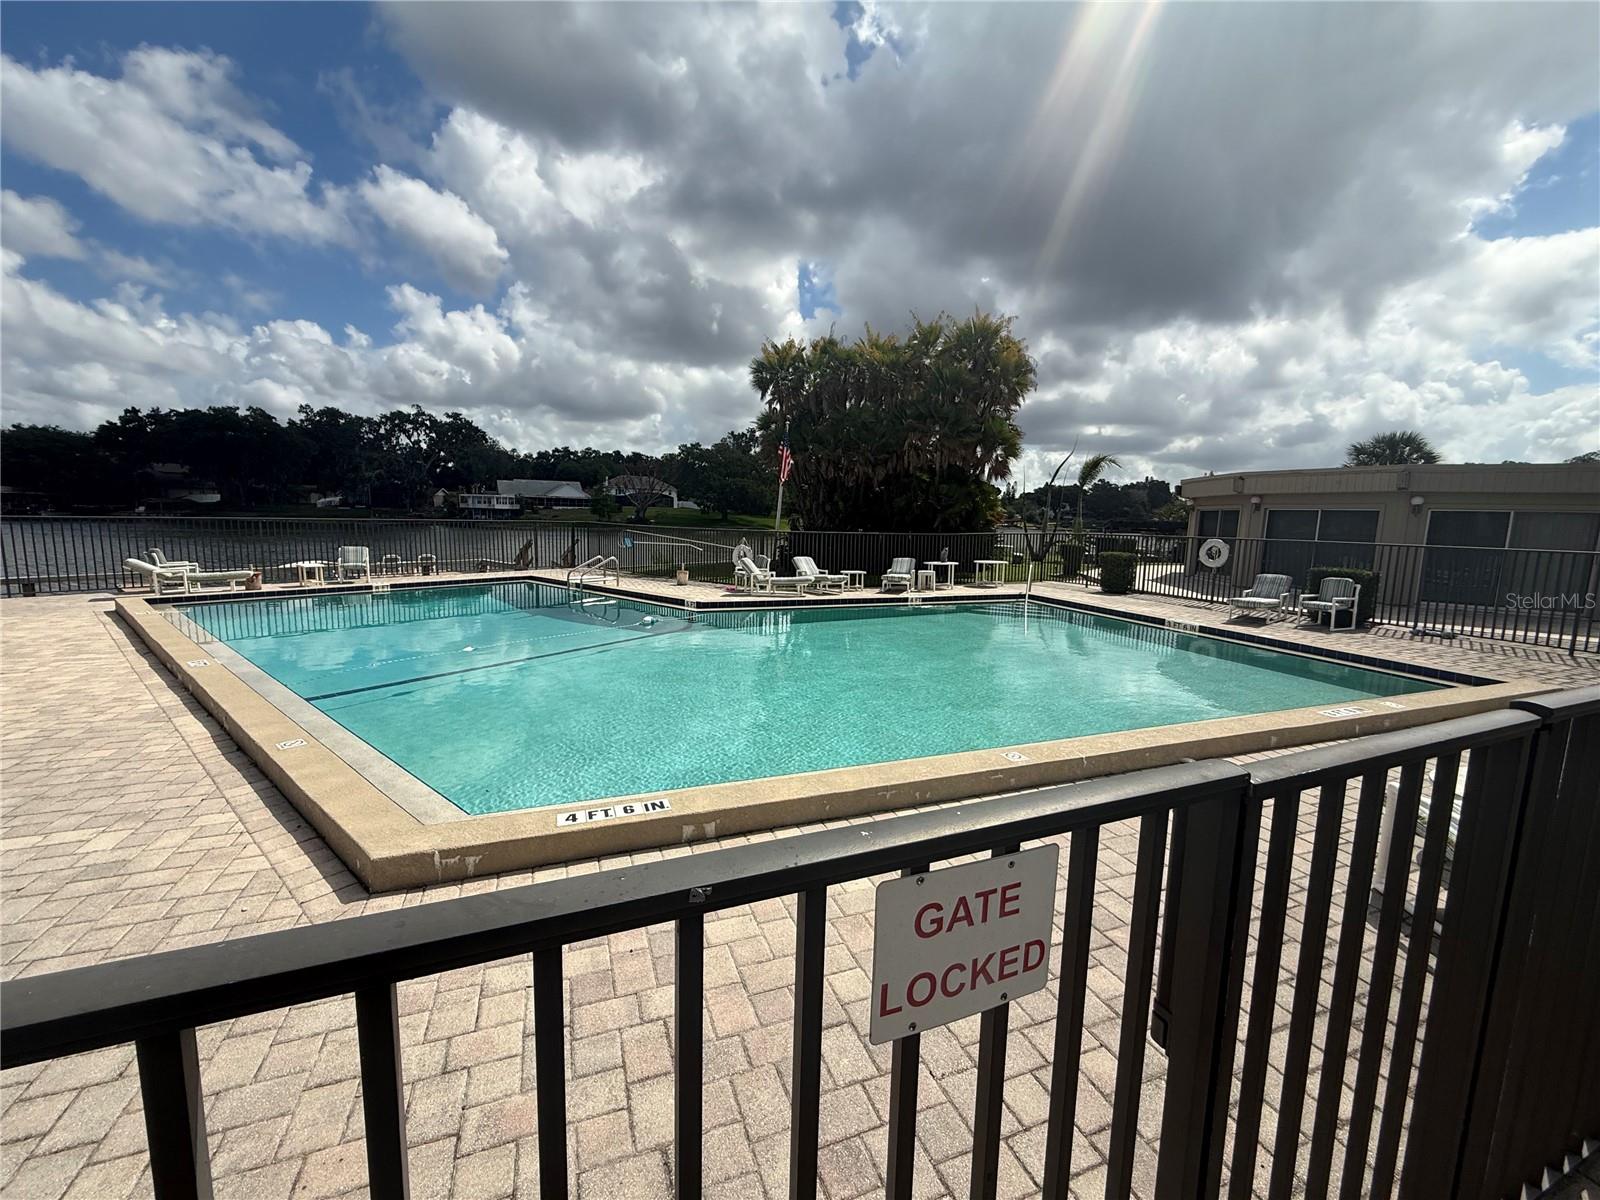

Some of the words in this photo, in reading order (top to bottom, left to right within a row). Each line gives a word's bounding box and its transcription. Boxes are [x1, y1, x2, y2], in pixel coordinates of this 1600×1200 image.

[565, 813, 578, 823] 4
[588, 808, 613, 820] FT.
[622, 805, 635, 814] 6
[643, 801, 669, 812] IN.
[914, 882, 1022, 939] GATE
[879, 939, 1046, 1018] LOCKED
